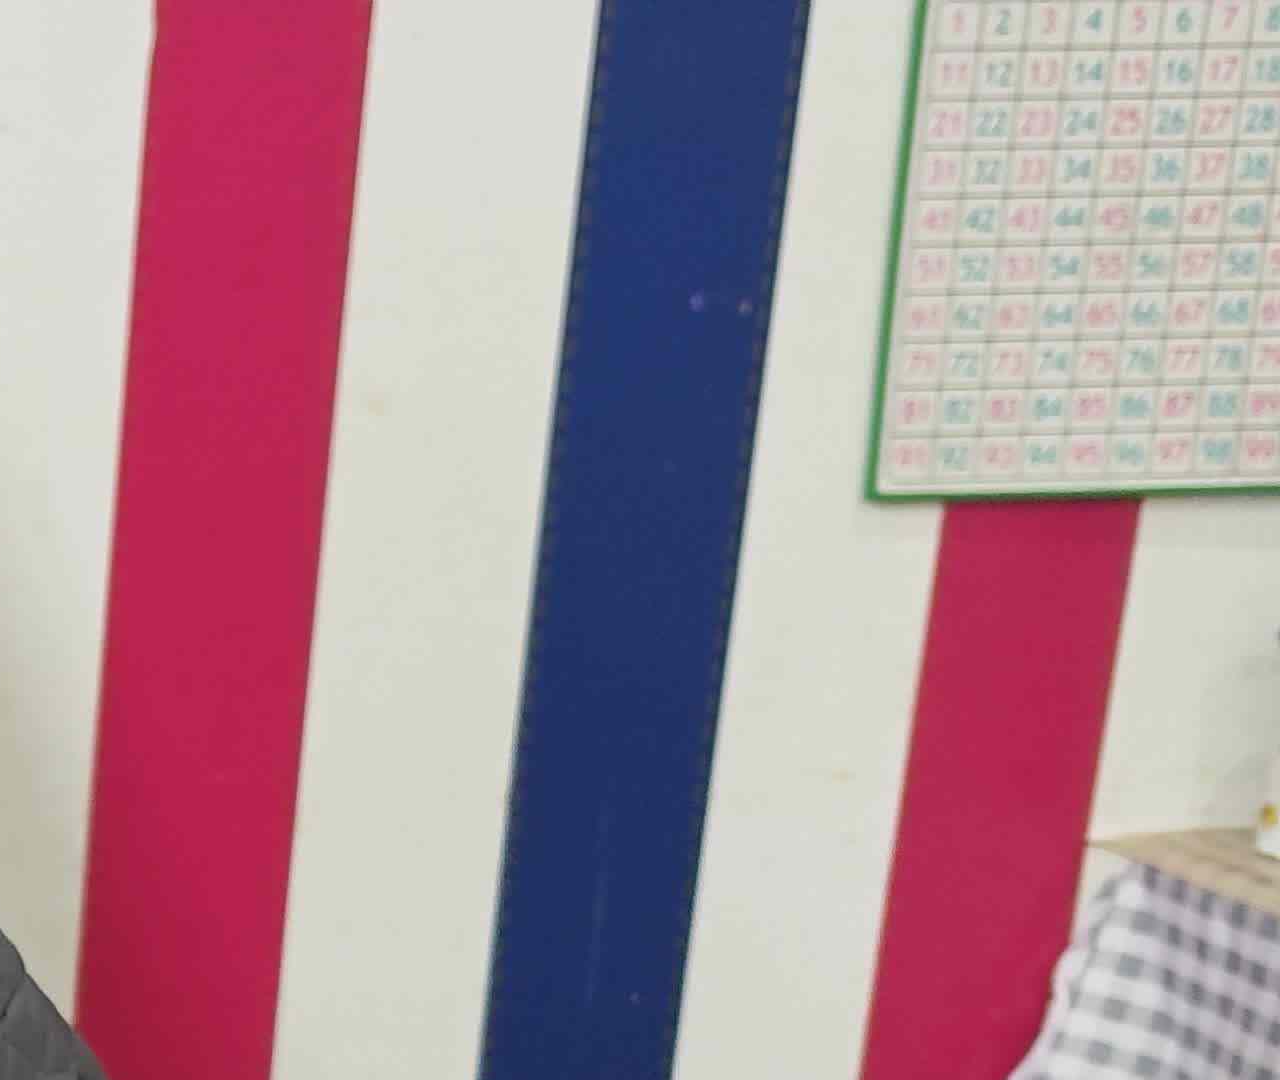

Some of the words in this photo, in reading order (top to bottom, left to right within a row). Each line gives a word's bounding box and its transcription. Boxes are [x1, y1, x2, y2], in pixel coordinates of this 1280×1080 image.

[953, 8, 964, 32] 1
[995, 8, 1012, 35] 2
[1044, 7, 1057, 33] 3
[1086, 8, 1104, 32] 4
[1134, 8, 1147, 32] 5
[1177, 7, 1192, 32] 6
[1223, 6, 1239, 31] 7
[1264, 6, 1280, 32] 8
